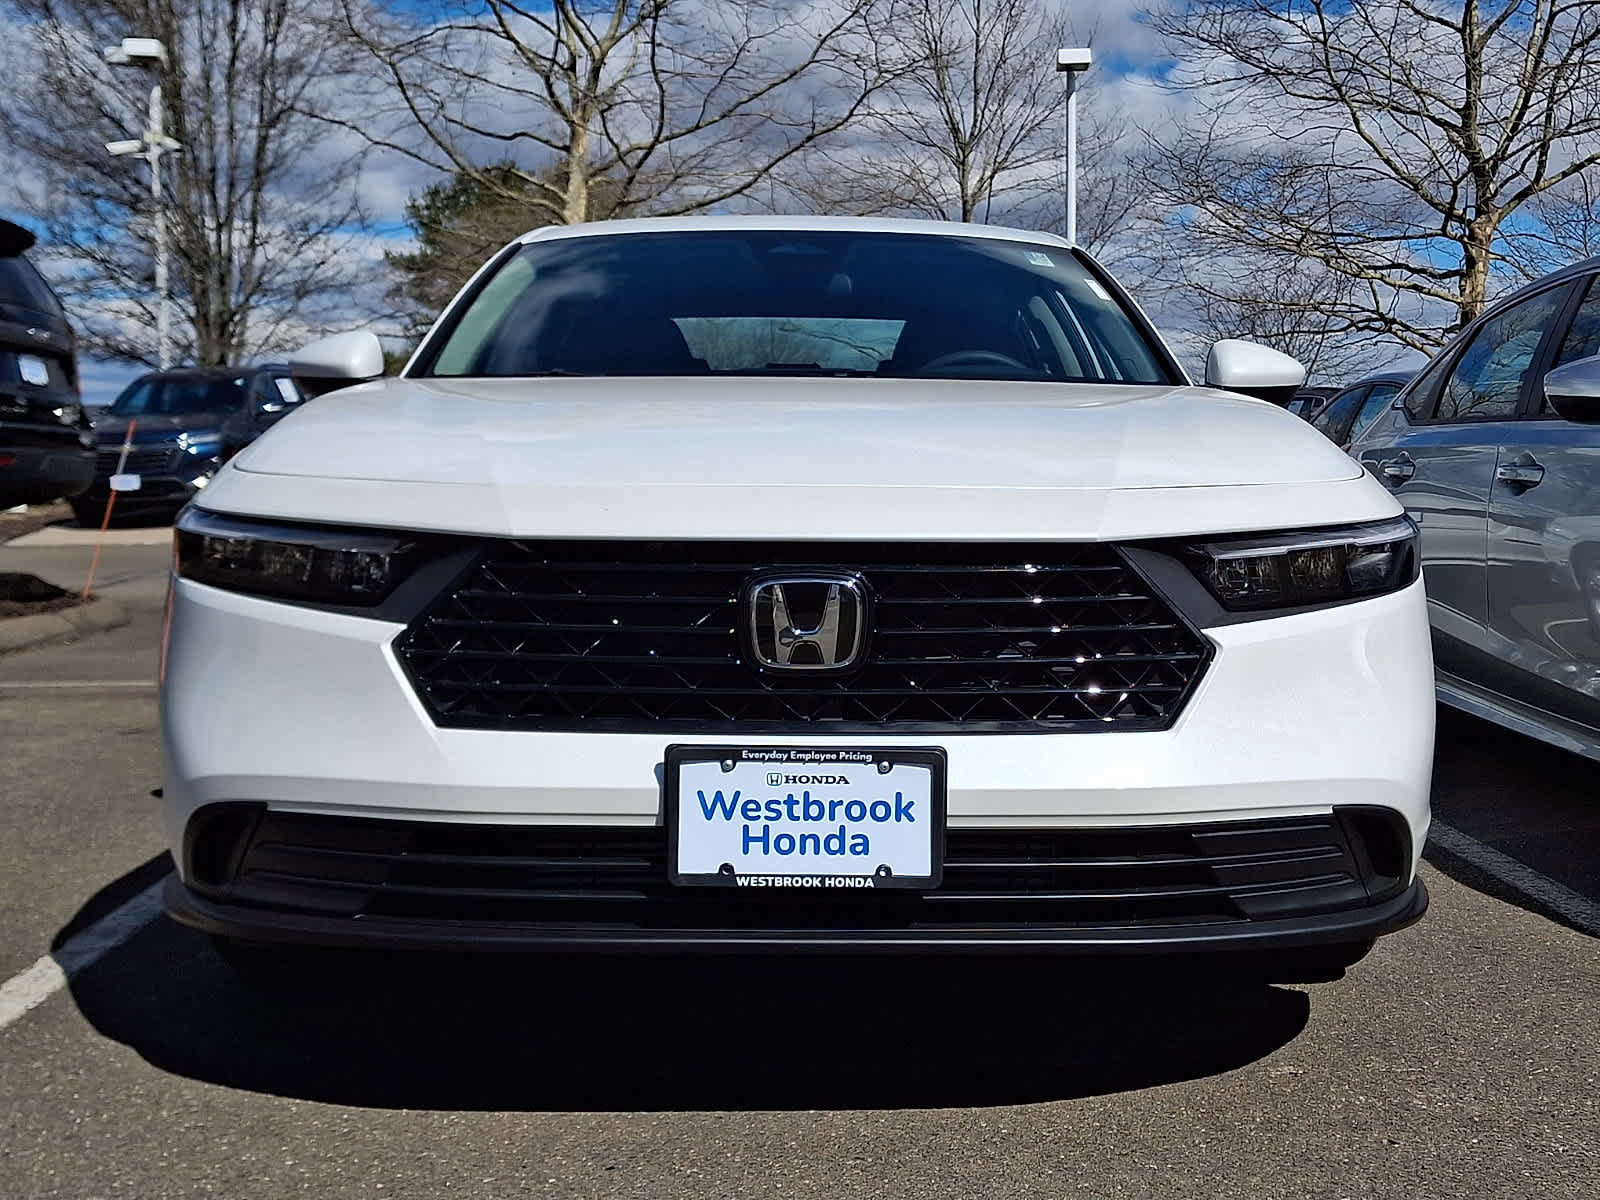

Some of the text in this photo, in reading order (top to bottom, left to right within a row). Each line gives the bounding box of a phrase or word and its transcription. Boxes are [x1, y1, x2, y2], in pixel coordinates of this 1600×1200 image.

[741, 750, 873, 762] Everyday Employee Pricing
[784, 775, 850, 785] HONDA
[697, 791, 916, 823] Westbrook
[742, 825, 870, 855] Honda
[736, 876, 875, 888] WESTBROOK HONDA
